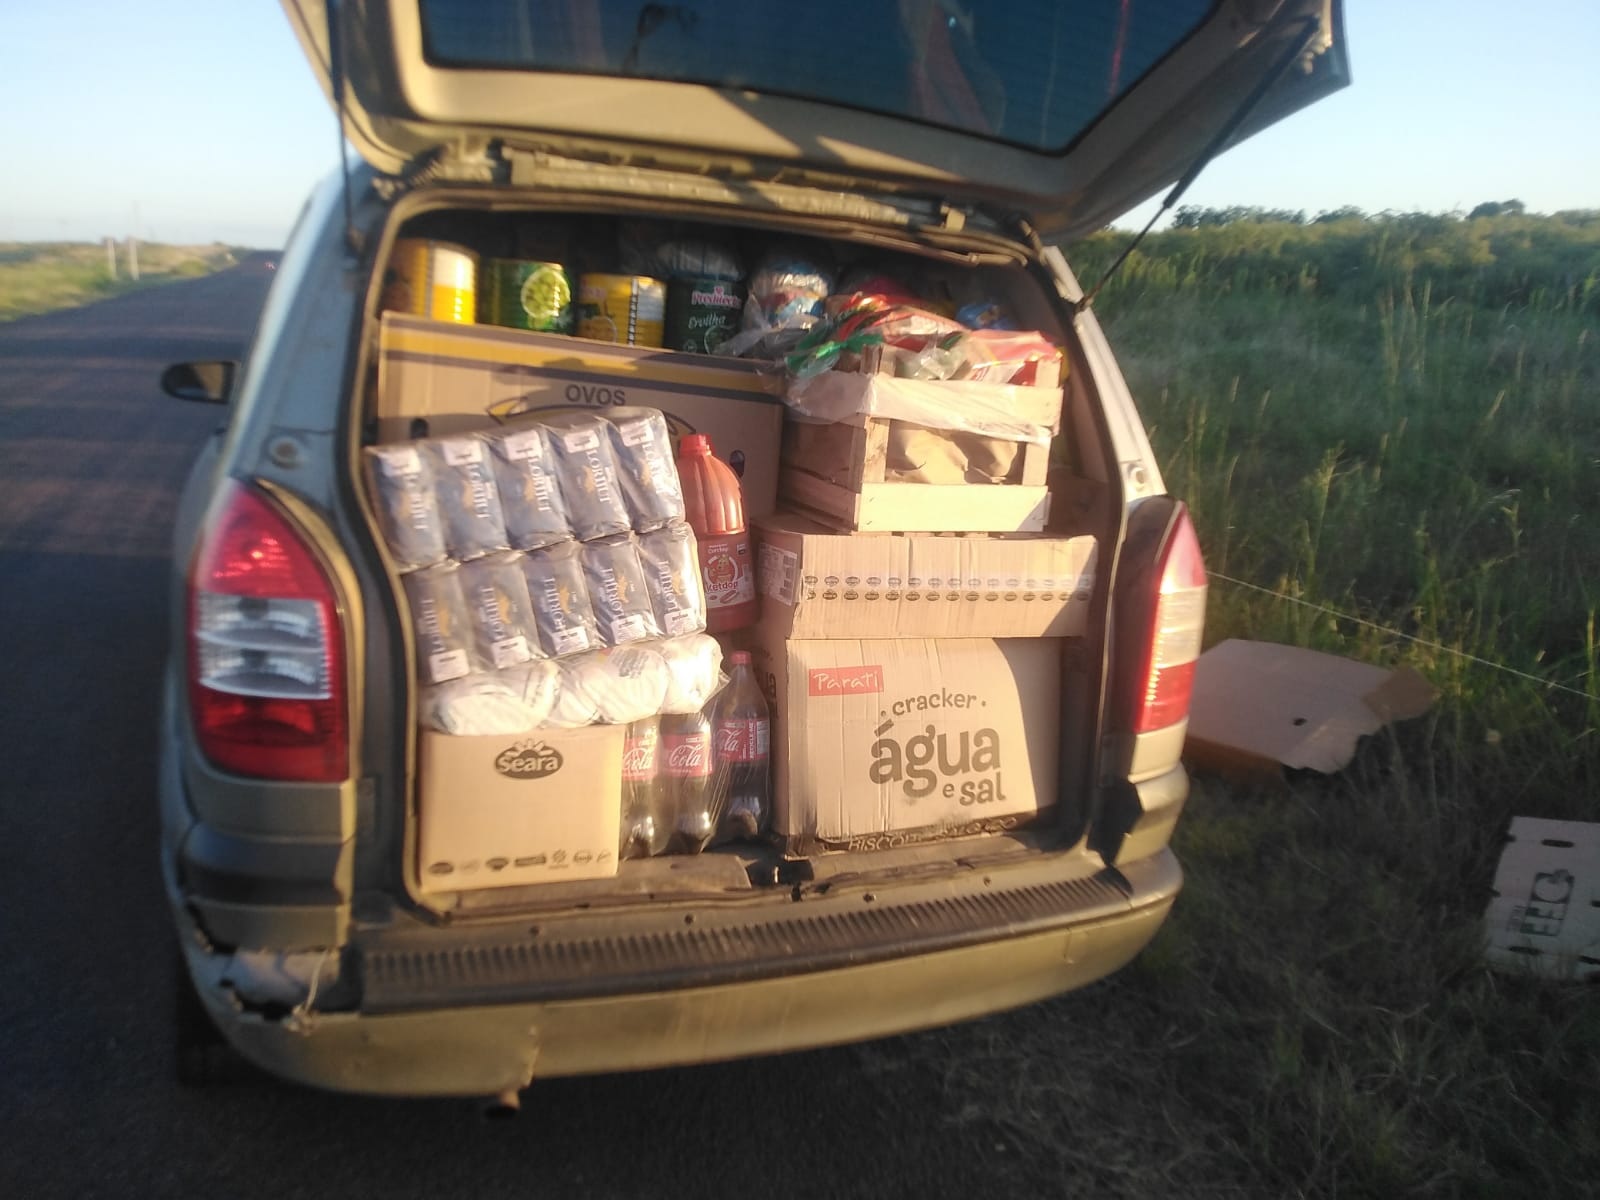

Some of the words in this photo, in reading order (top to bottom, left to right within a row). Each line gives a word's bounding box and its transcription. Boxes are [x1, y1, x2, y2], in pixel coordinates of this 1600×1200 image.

[565, 384, 626, 406] OVOS
[813, 671, 878, 691] Parati
[892, 687, 977, 716] cracker
[498, 756, 559, 773] Seara
[669, 744, 705, 768] Cola
[869, 718, 1001, 798] água
[942, 783, 955, 798] e
[959, 771, 1006, 806] sal
